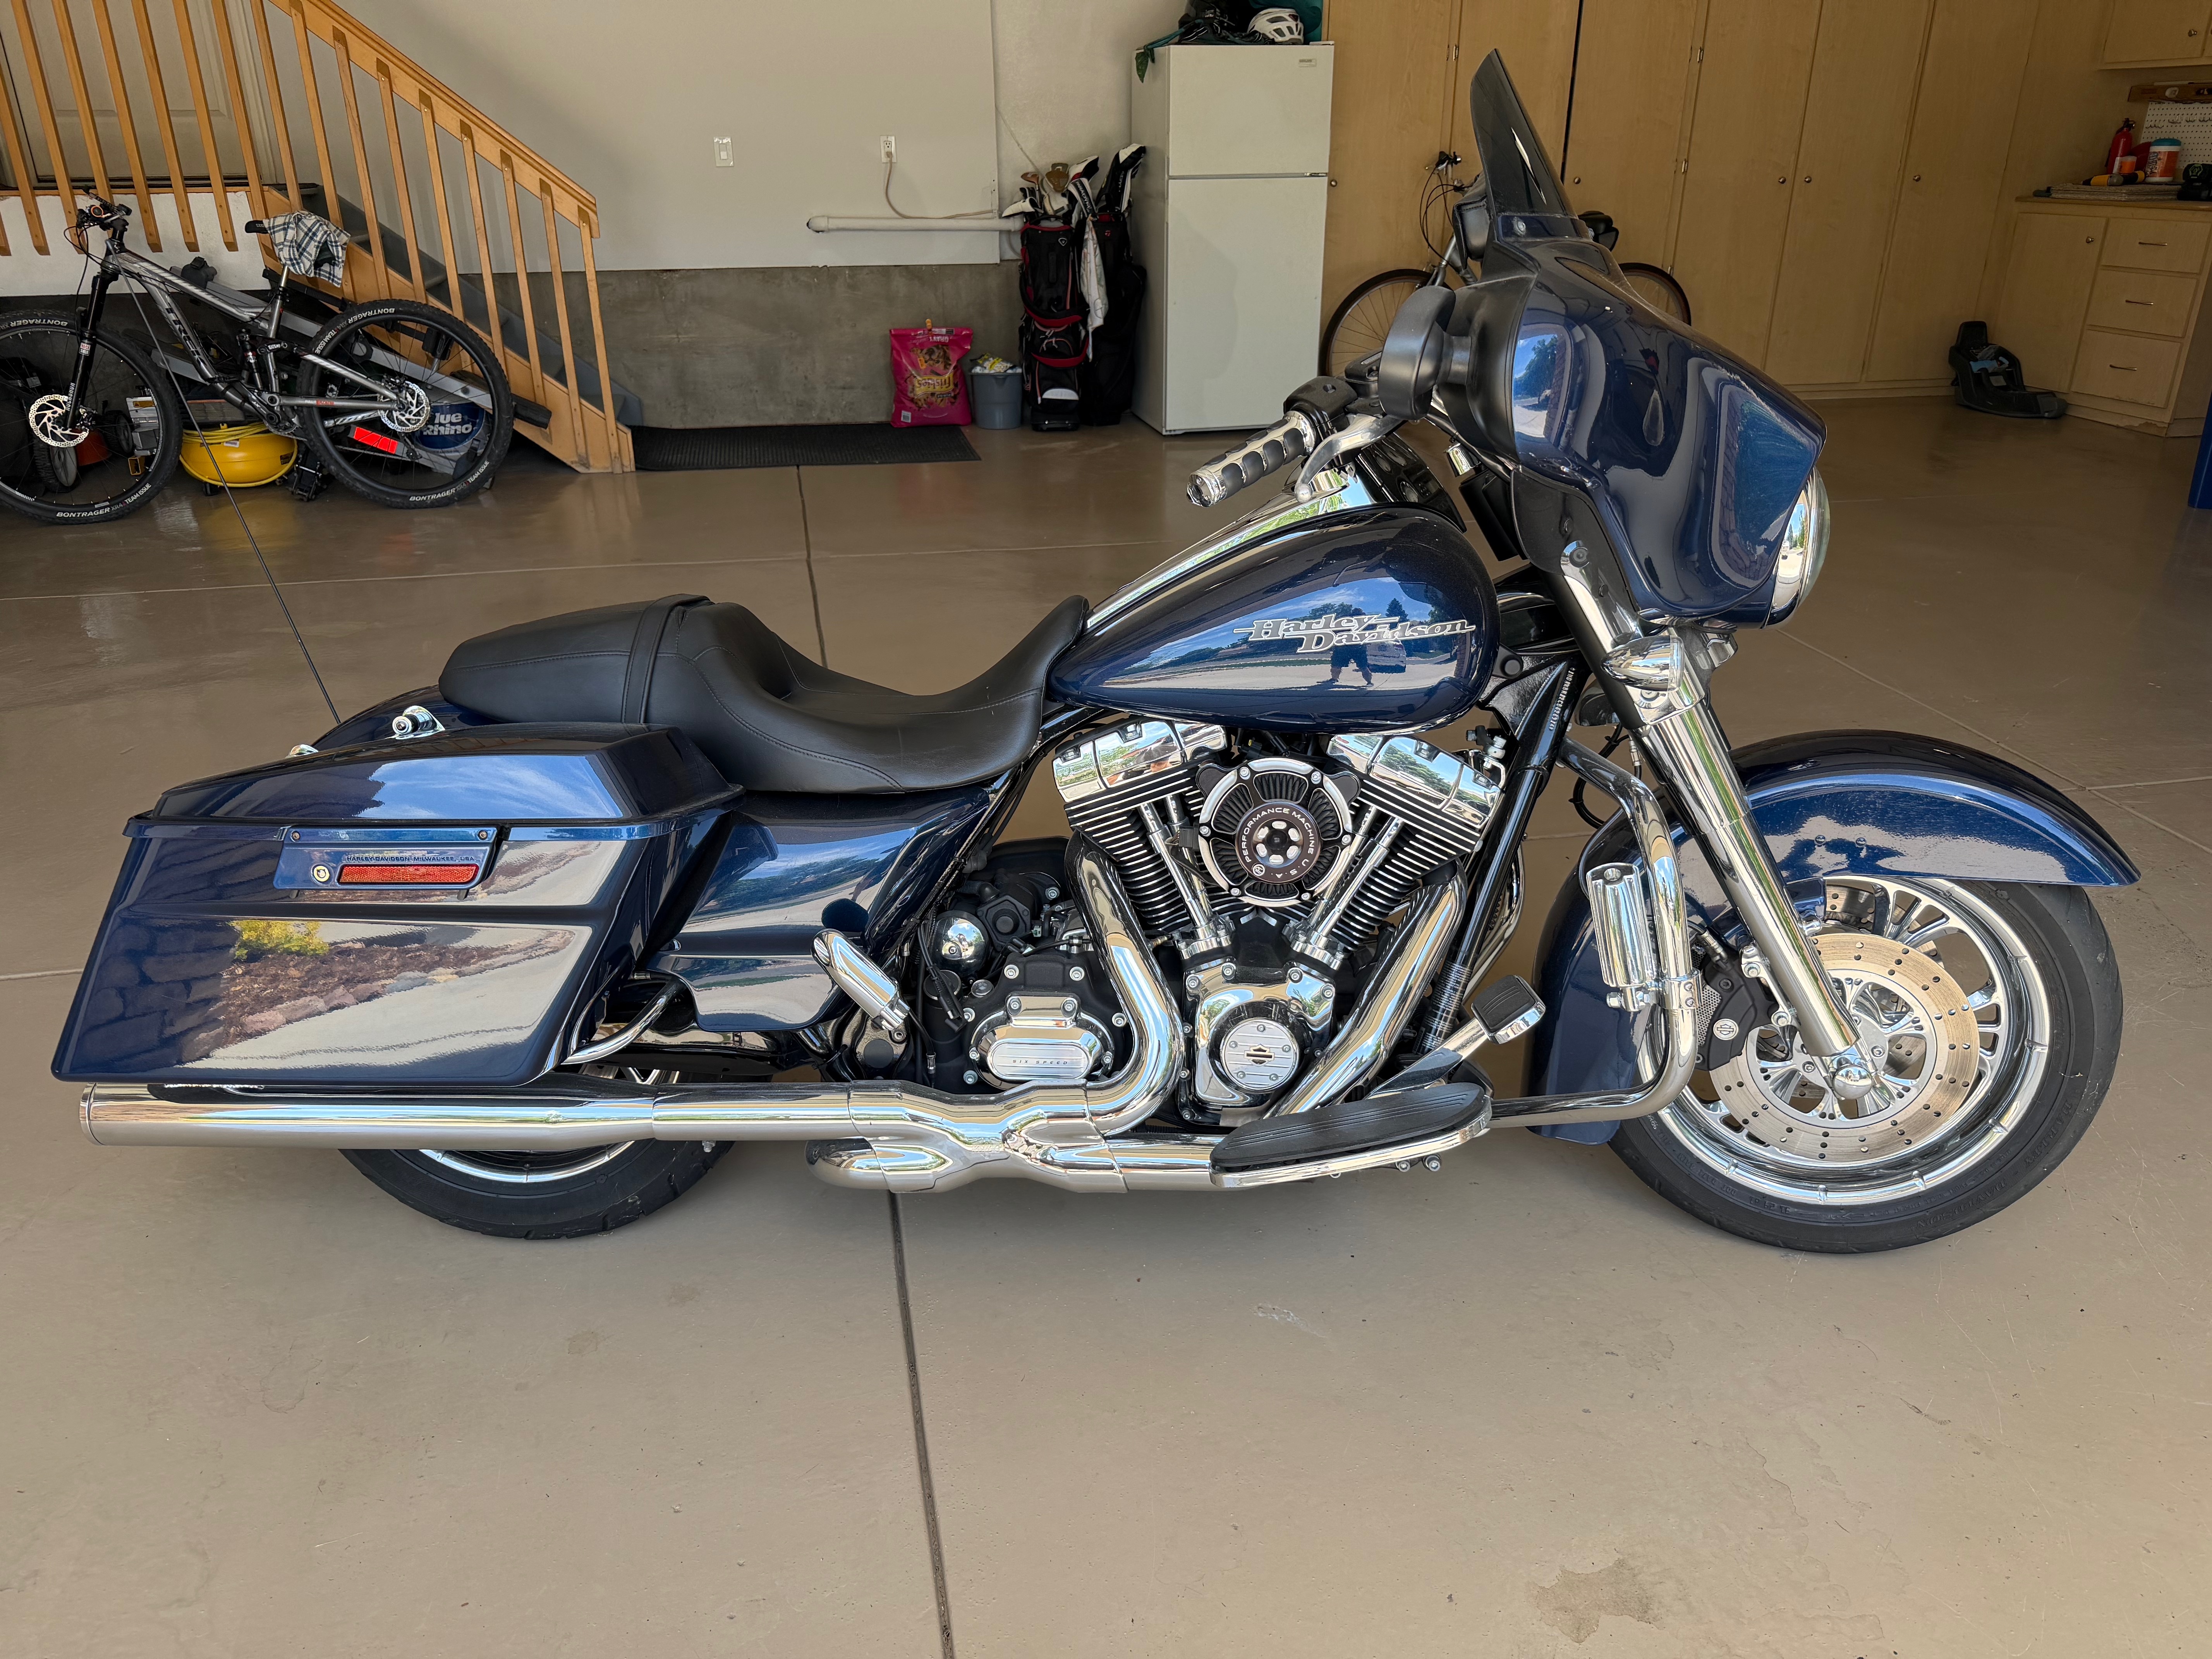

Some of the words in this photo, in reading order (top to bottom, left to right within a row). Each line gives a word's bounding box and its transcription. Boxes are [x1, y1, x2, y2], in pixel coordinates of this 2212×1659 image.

[10, 319, 68, 327] BONTRAGER
[349, 308, 395, 324] BONTRAGER
[165, 302, 207, 367] TREK
[315, 341, 326, 355] ISSUE
[323, 330, 337, 342] TEAM
[422, 423, 472, 435] Rhino
[56, 507, 110, 517] BONTRAGER
[124, 493, 140, 504] TEAM
[138, 483, 151, 496] ISSUE
[409, 488, 455, 501] BONTRAGER
[467, 471, 480, 483] TEAM
[1233, 613, 1400, 641] Harley
[1283, 619, 1476, 653] Davidson
[1242, 807, 1290, 862] PERFORMANCE
[1291, 811, 1315, 854] MACHINE
[2025, 1100, 2073, 1167] HARLEY
